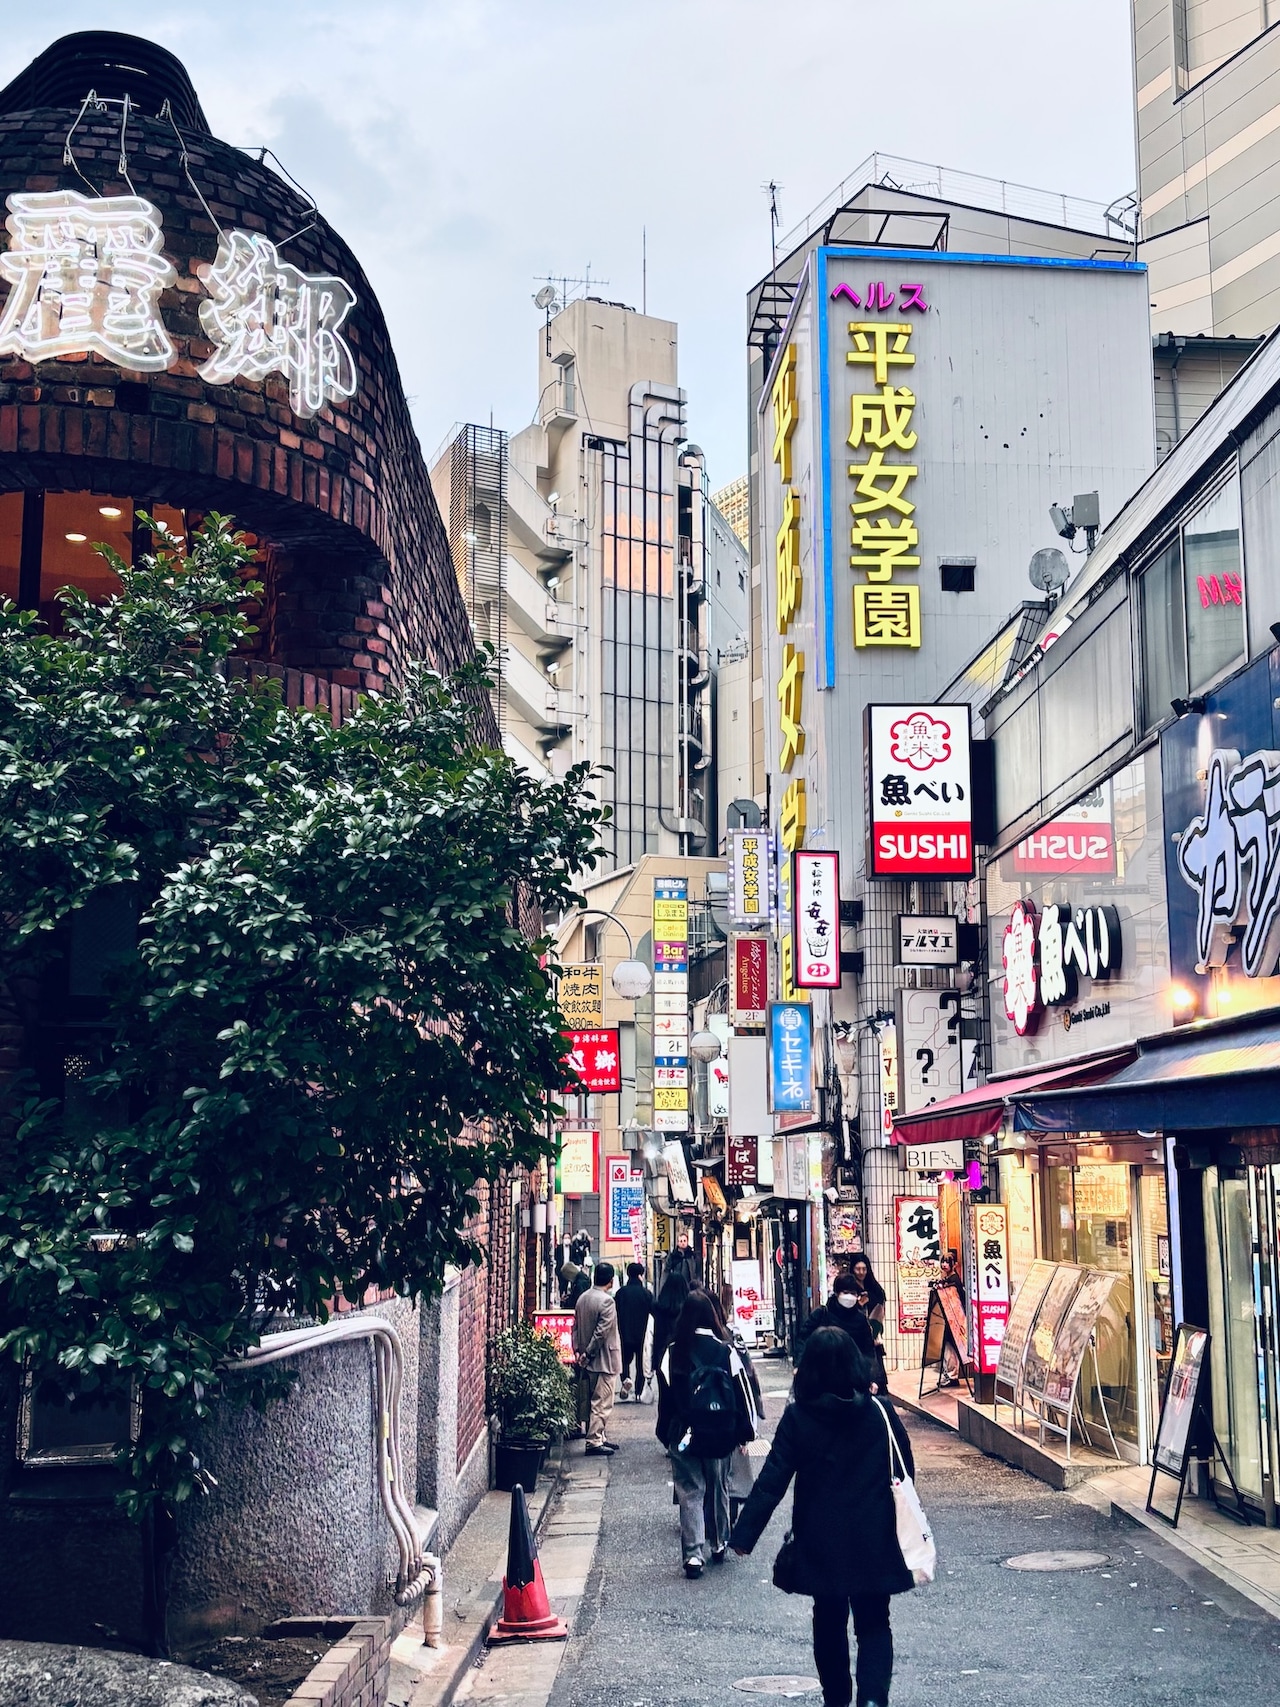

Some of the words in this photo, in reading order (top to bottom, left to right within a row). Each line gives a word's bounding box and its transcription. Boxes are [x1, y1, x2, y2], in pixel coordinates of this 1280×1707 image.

[831, 281, 928, 313] ヘルス
[846, 321, 922, 650] 平成女学園
[880, 774, 965, 806] 魚べい
[879, 834, 967, 859] SUSHI
[742, 838, 760, 913] 平成女学園
[663, 944, 685, 955] Bar
[902, 935, 954, 948] テルマエ
[1038, 905, 1110, 1006] 魚べい
[563, 966, 600, 980] 和牛
[811, 965, 828, 977] 2F
[563, 982, 600, 997] 焼肉
[745, 1011, 760, 1021] 2F
[782, 1009, 801, 1030] 質
[658, 1069, 685, 1079] たばこ
[781, 1031, 804, 1098] セキネ
[800, 1100, 810, 1110] 1F
[729, 1136, 756, 1178] たばこ
[908, 1150, 939, 1168] B1F
[983, 1239, 1003, 1289] 魚べい
[981, 1305, 1007, 1314] SUSHI
